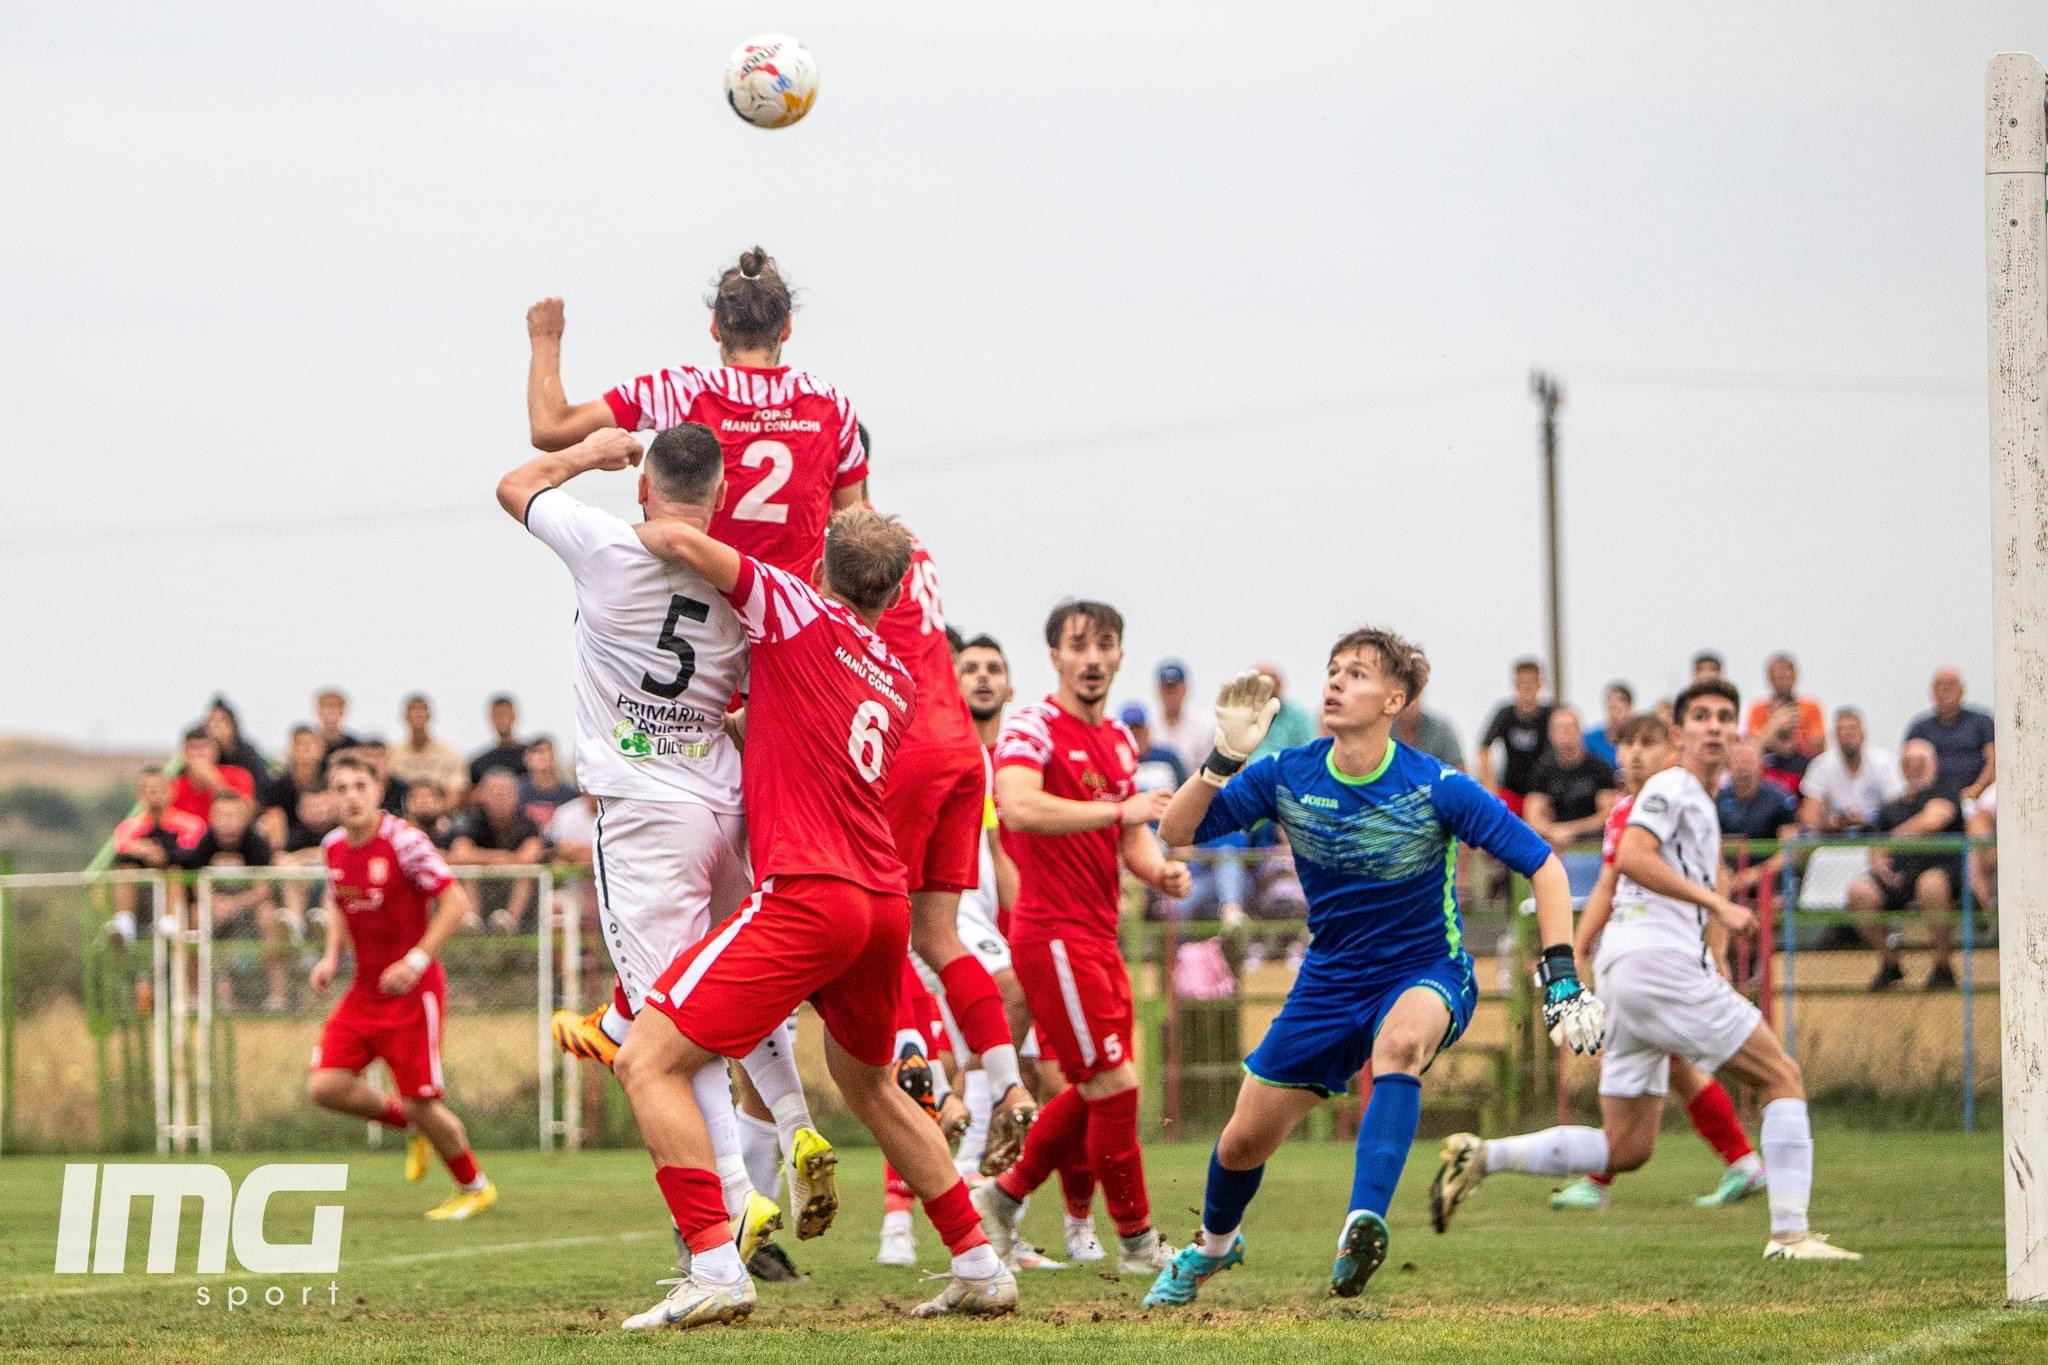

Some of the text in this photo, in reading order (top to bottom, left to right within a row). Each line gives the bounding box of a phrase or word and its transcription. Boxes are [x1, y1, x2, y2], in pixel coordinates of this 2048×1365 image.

[721, 418, 821, 433] HANU CONACHI
[752, 407, 793, 421] POPS
[731, 439, 794, 524] 2
[640, 593, 710, 699] 5
[861, 654, 894, 687] POPAS
[834, 646, 909, 714] HANU CONACHI
[848, 700, 889, 784] 6
[1103, 1032, 1123, 1063] 5
